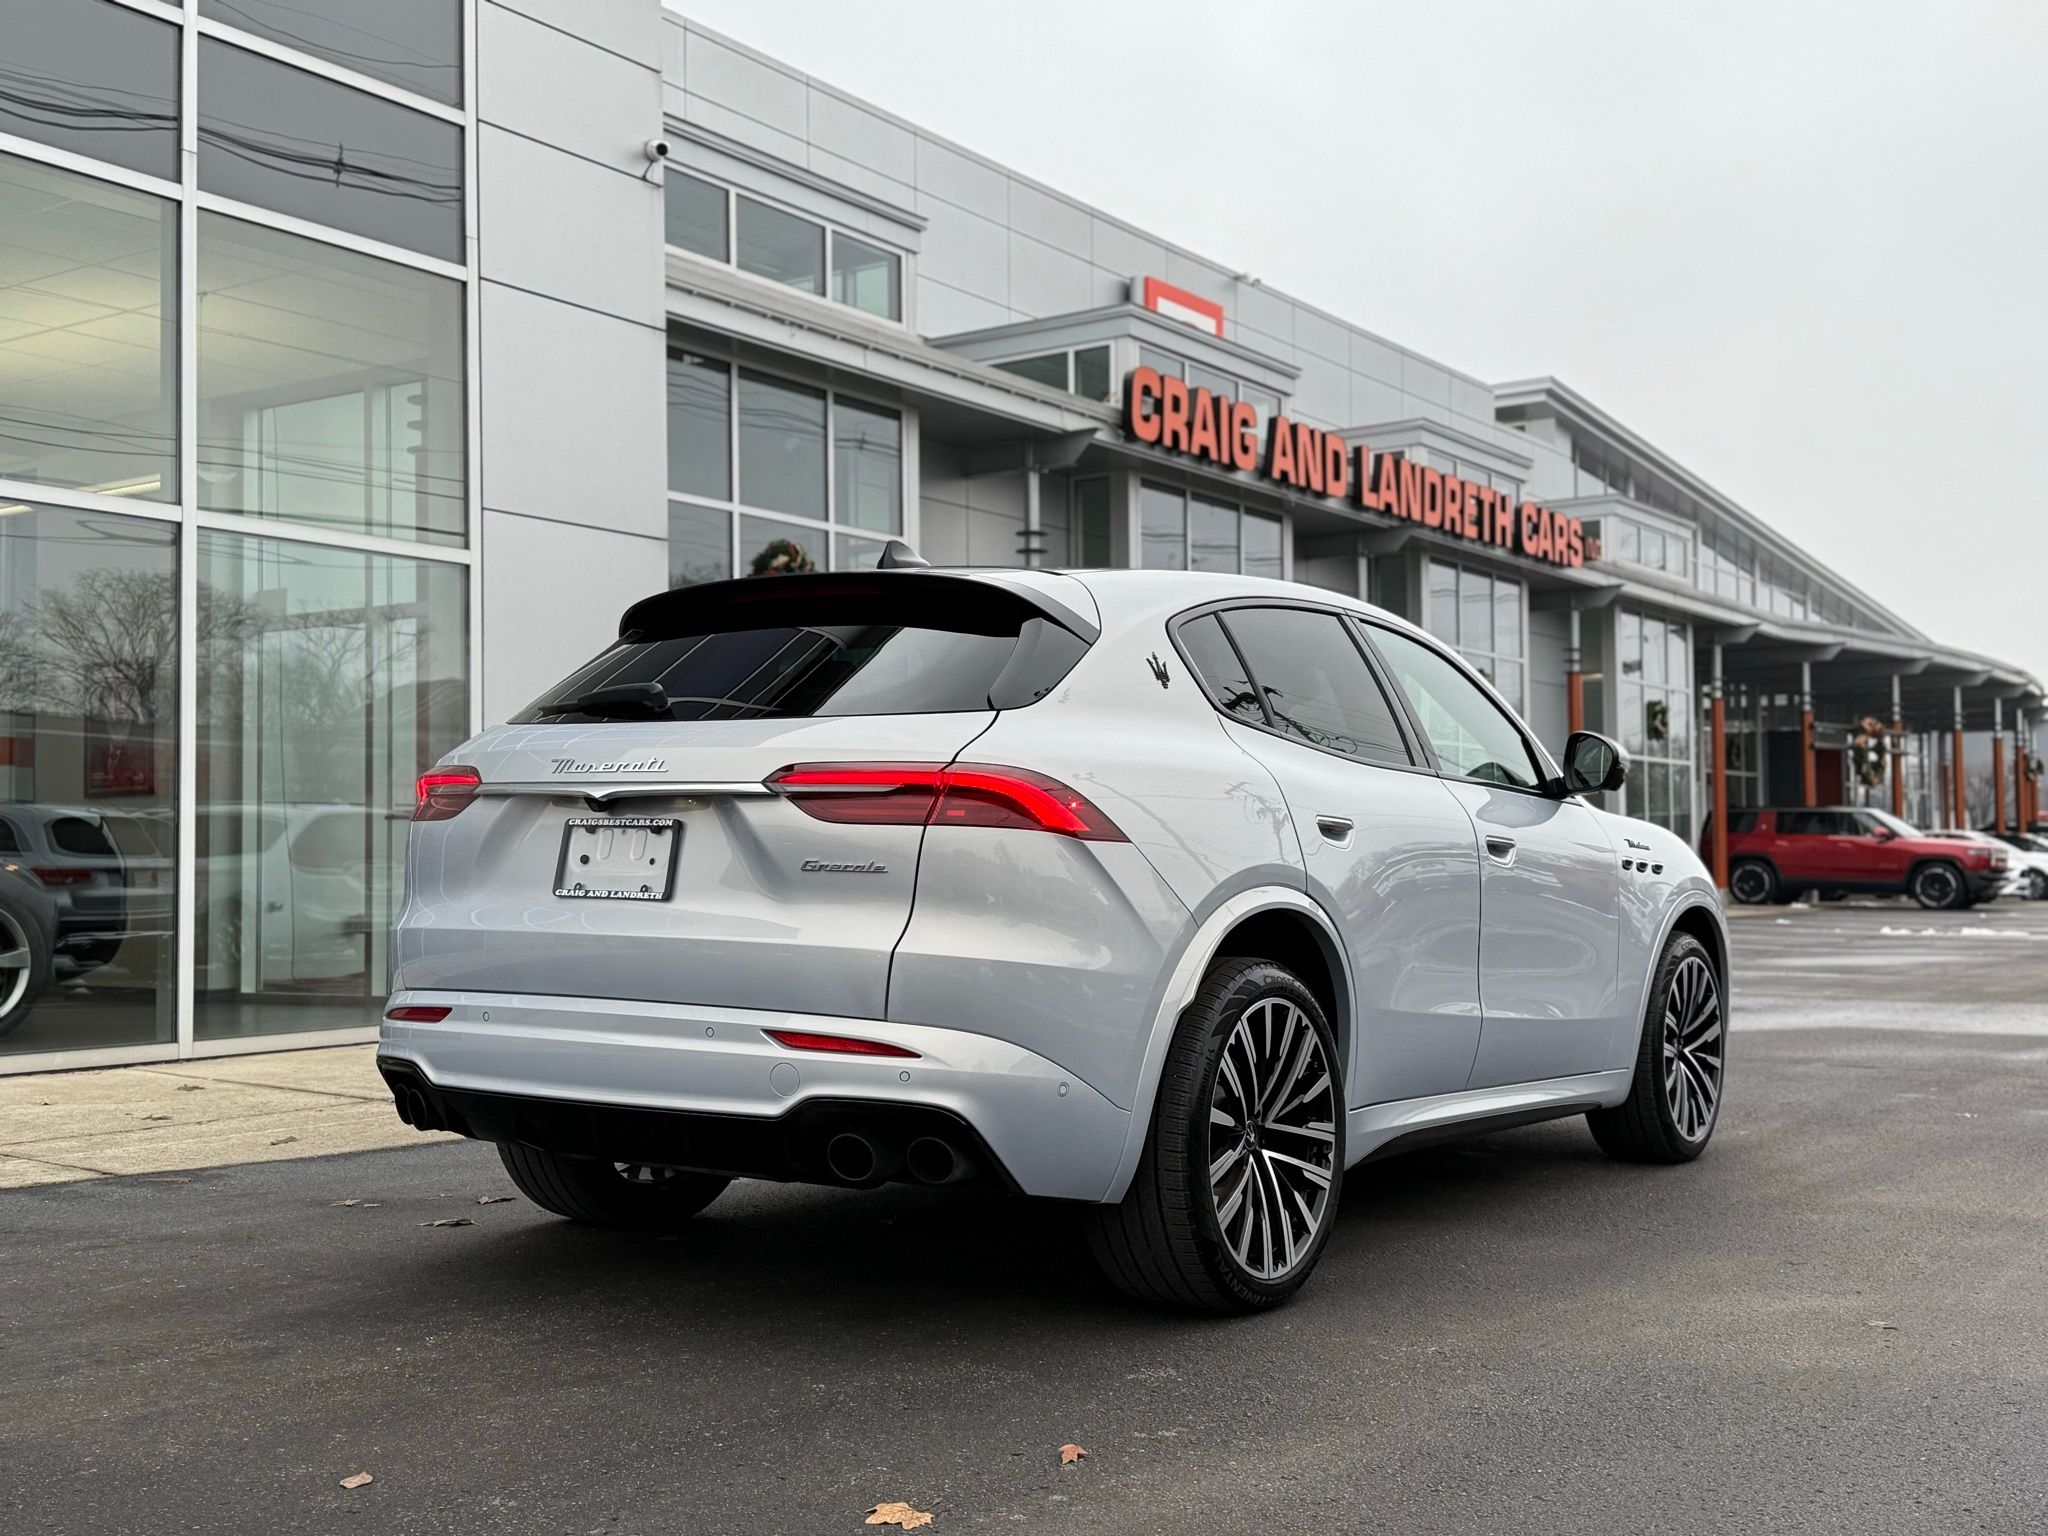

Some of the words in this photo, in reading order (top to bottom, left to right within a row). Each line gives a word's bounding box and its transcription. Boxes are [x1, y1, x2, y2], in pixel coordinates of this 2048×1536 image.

[1131, 366, 1258, 471] CRAIG
[1271, 416, 1348, 498] AND
[1360, 446, 1513, 548] LANDRETH
[1521, 502, 1583, 568] CARS
[551, 757, 668, 774] Maserati
[568, 818, 673, 827] CRAIGSBESTCARS.COM
[800, 859, 889, 874] Grecale
[555, 888, 587, 898] CRAIG
[587, 890, 609, 899] AND
[610, 890, 664, 900] LANDRETH
